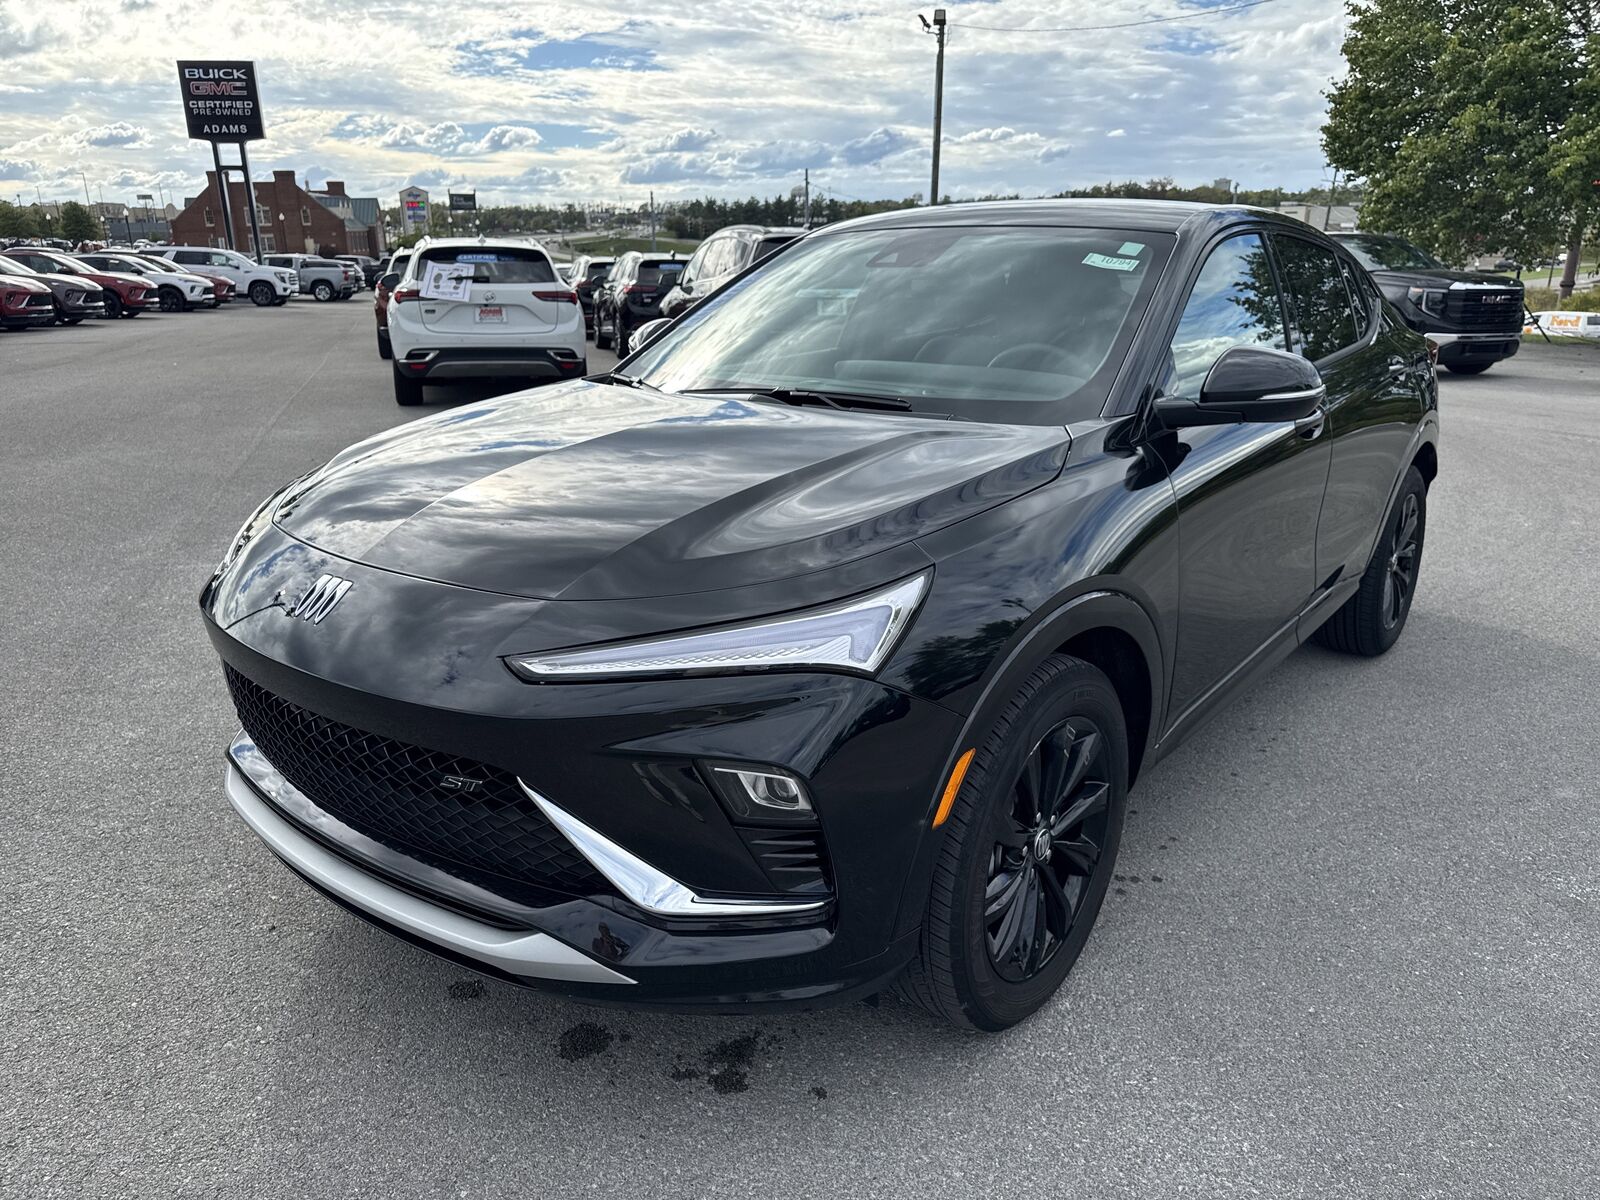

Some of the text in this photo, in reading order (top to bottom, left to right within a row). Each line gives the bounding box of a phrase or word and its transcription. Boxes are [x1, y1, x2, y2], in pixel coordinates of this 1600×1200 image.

[184, 68, 248, 79] BUICK
[190, 81, 247, 95] GMC
[203, 124, 247, 133] ADAMS
[1101, 257, 1132, 265] 10794
[440, 775, 483, 792] ST
